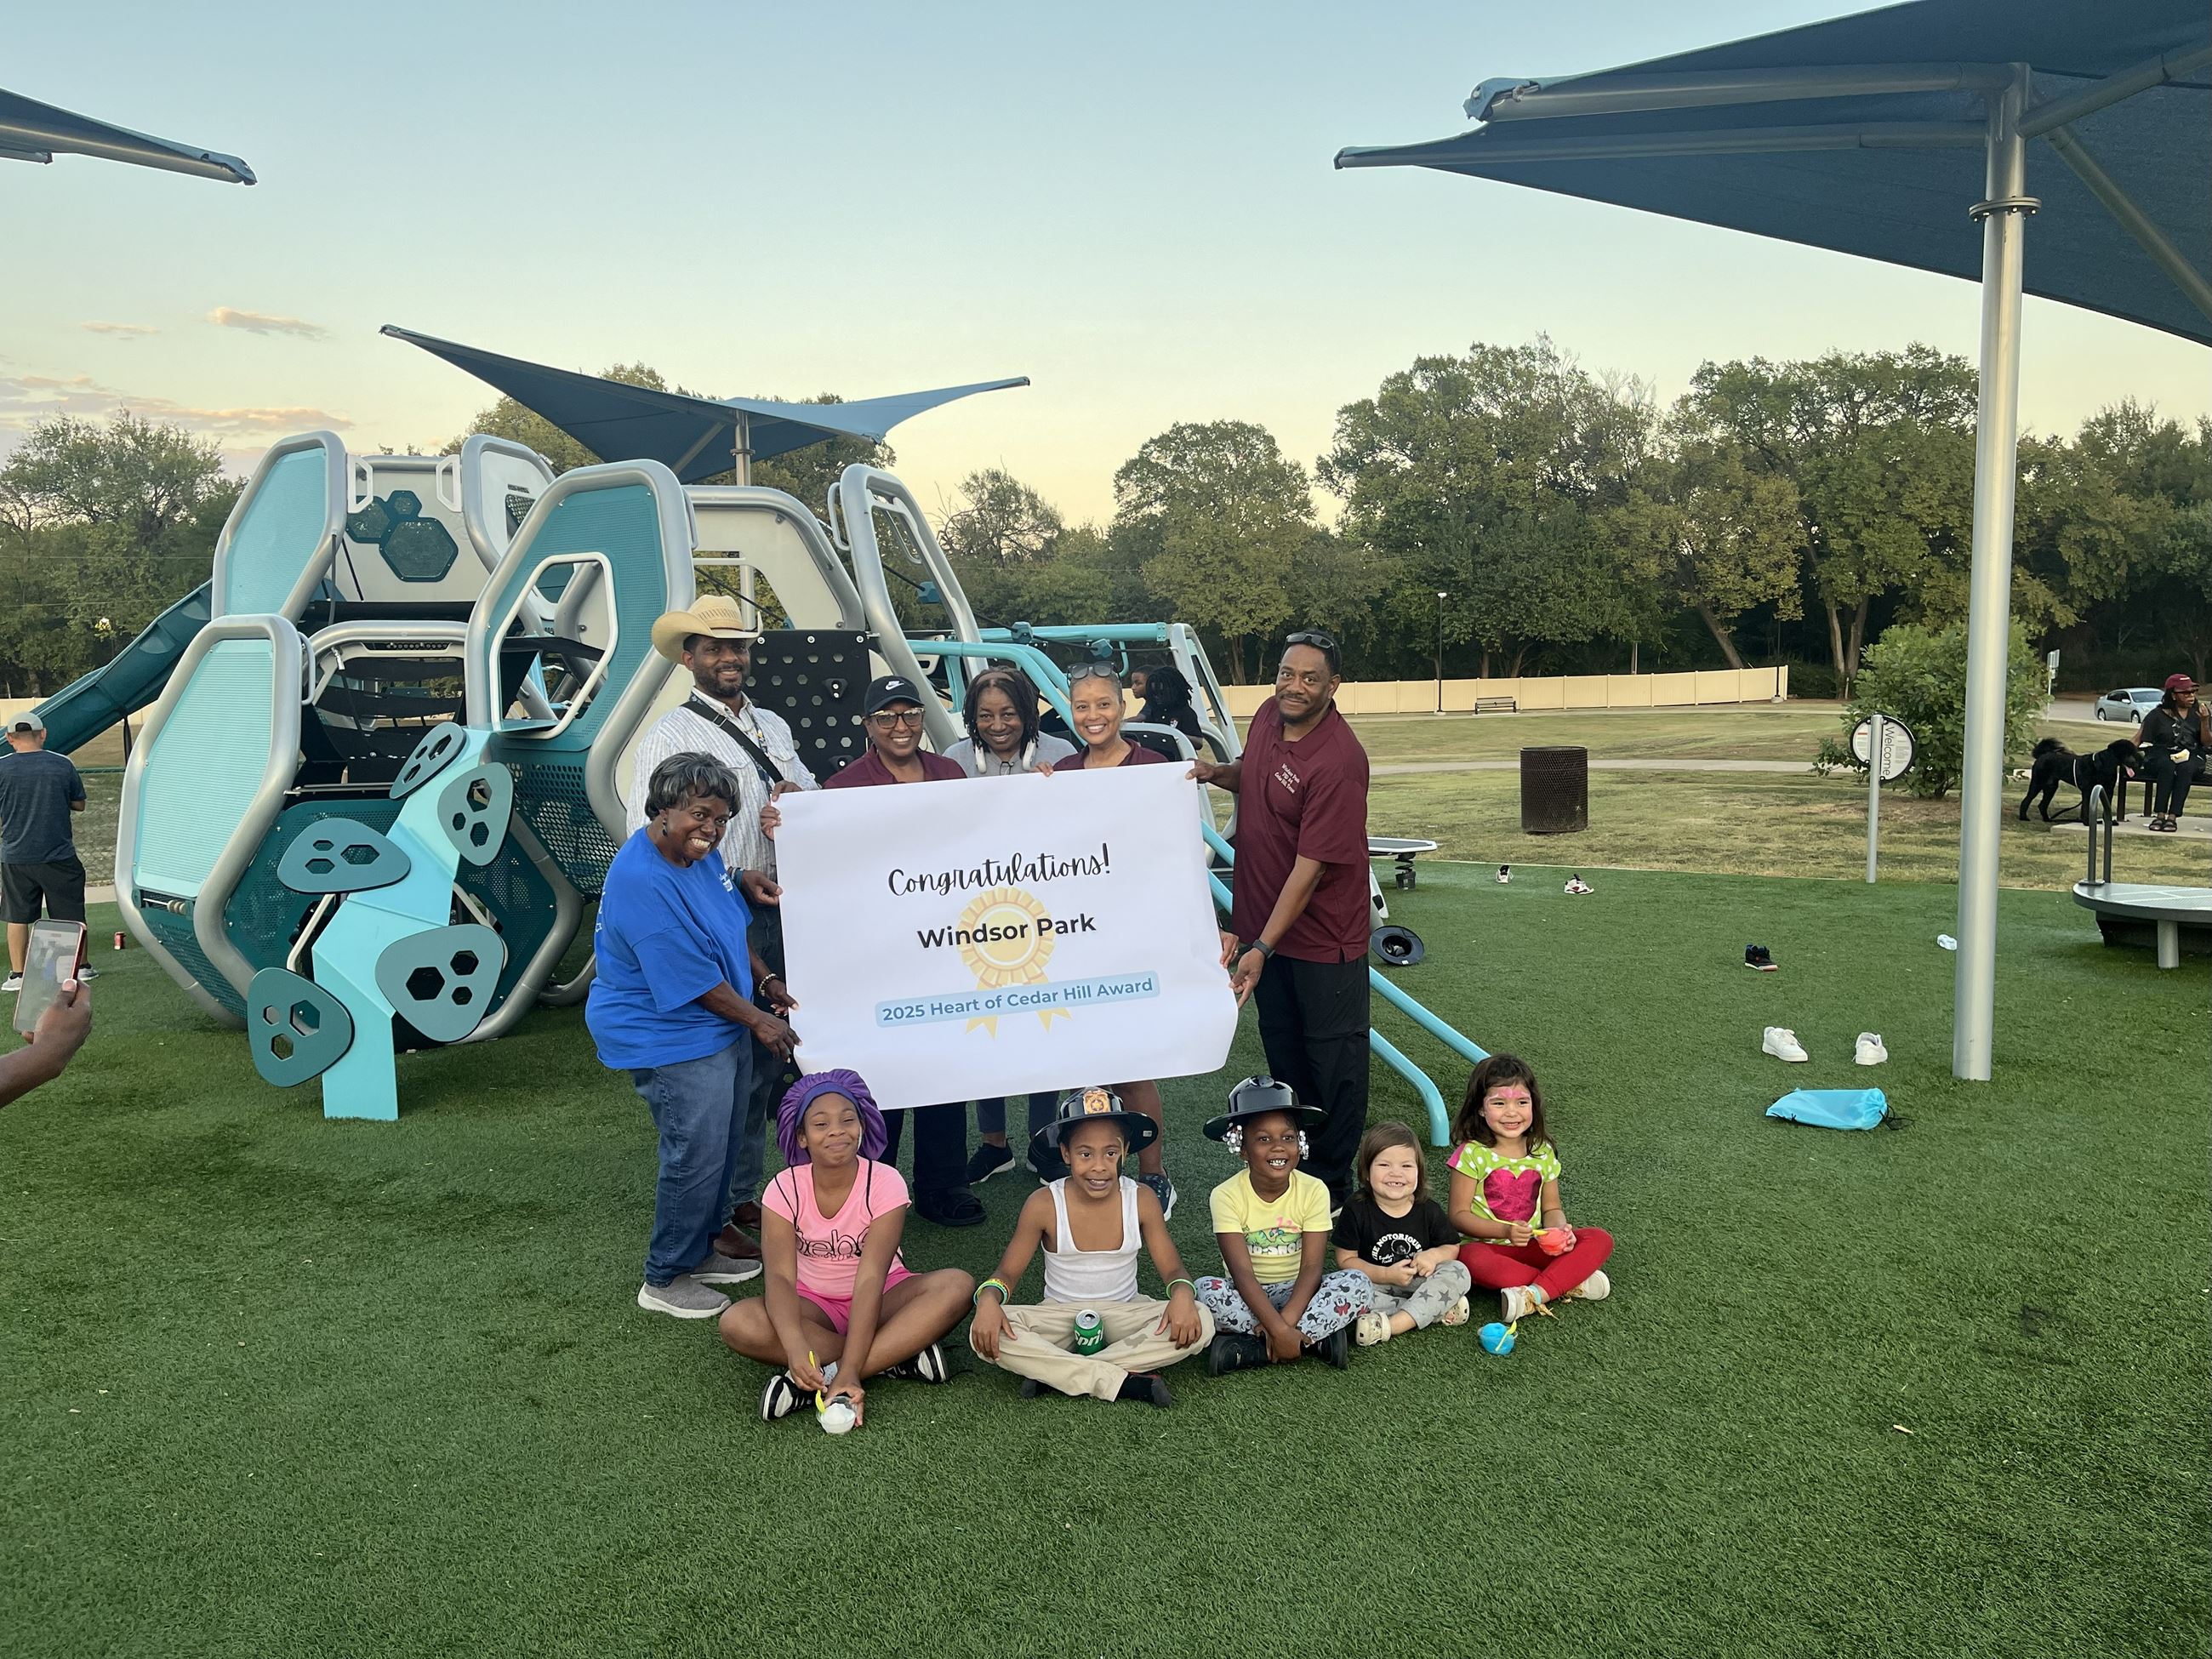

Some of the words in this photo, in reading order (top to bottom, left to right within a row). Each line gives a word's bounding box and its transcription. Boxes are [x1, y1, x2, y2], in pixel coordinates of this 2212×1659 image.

[1882, 726, 1896, 776] Welcome
[888, 842, 1110, 896] Congratulations!
[917, 923, 1029, 949] Windsor
[1036, 913, 1097, 937] Park
[882, 1004, 926, 1021] 2025
[931, 999, 980, 1016] Heart
[984, 995, 1002, 1010] of
[1006, 990, 1058, 1006] Cedar
[1063, 984, 1092, 1001] Hill
[1097, 978, 1153, 997] Award
[1377, 1233, 1422, 1250] NOTORIOUS
